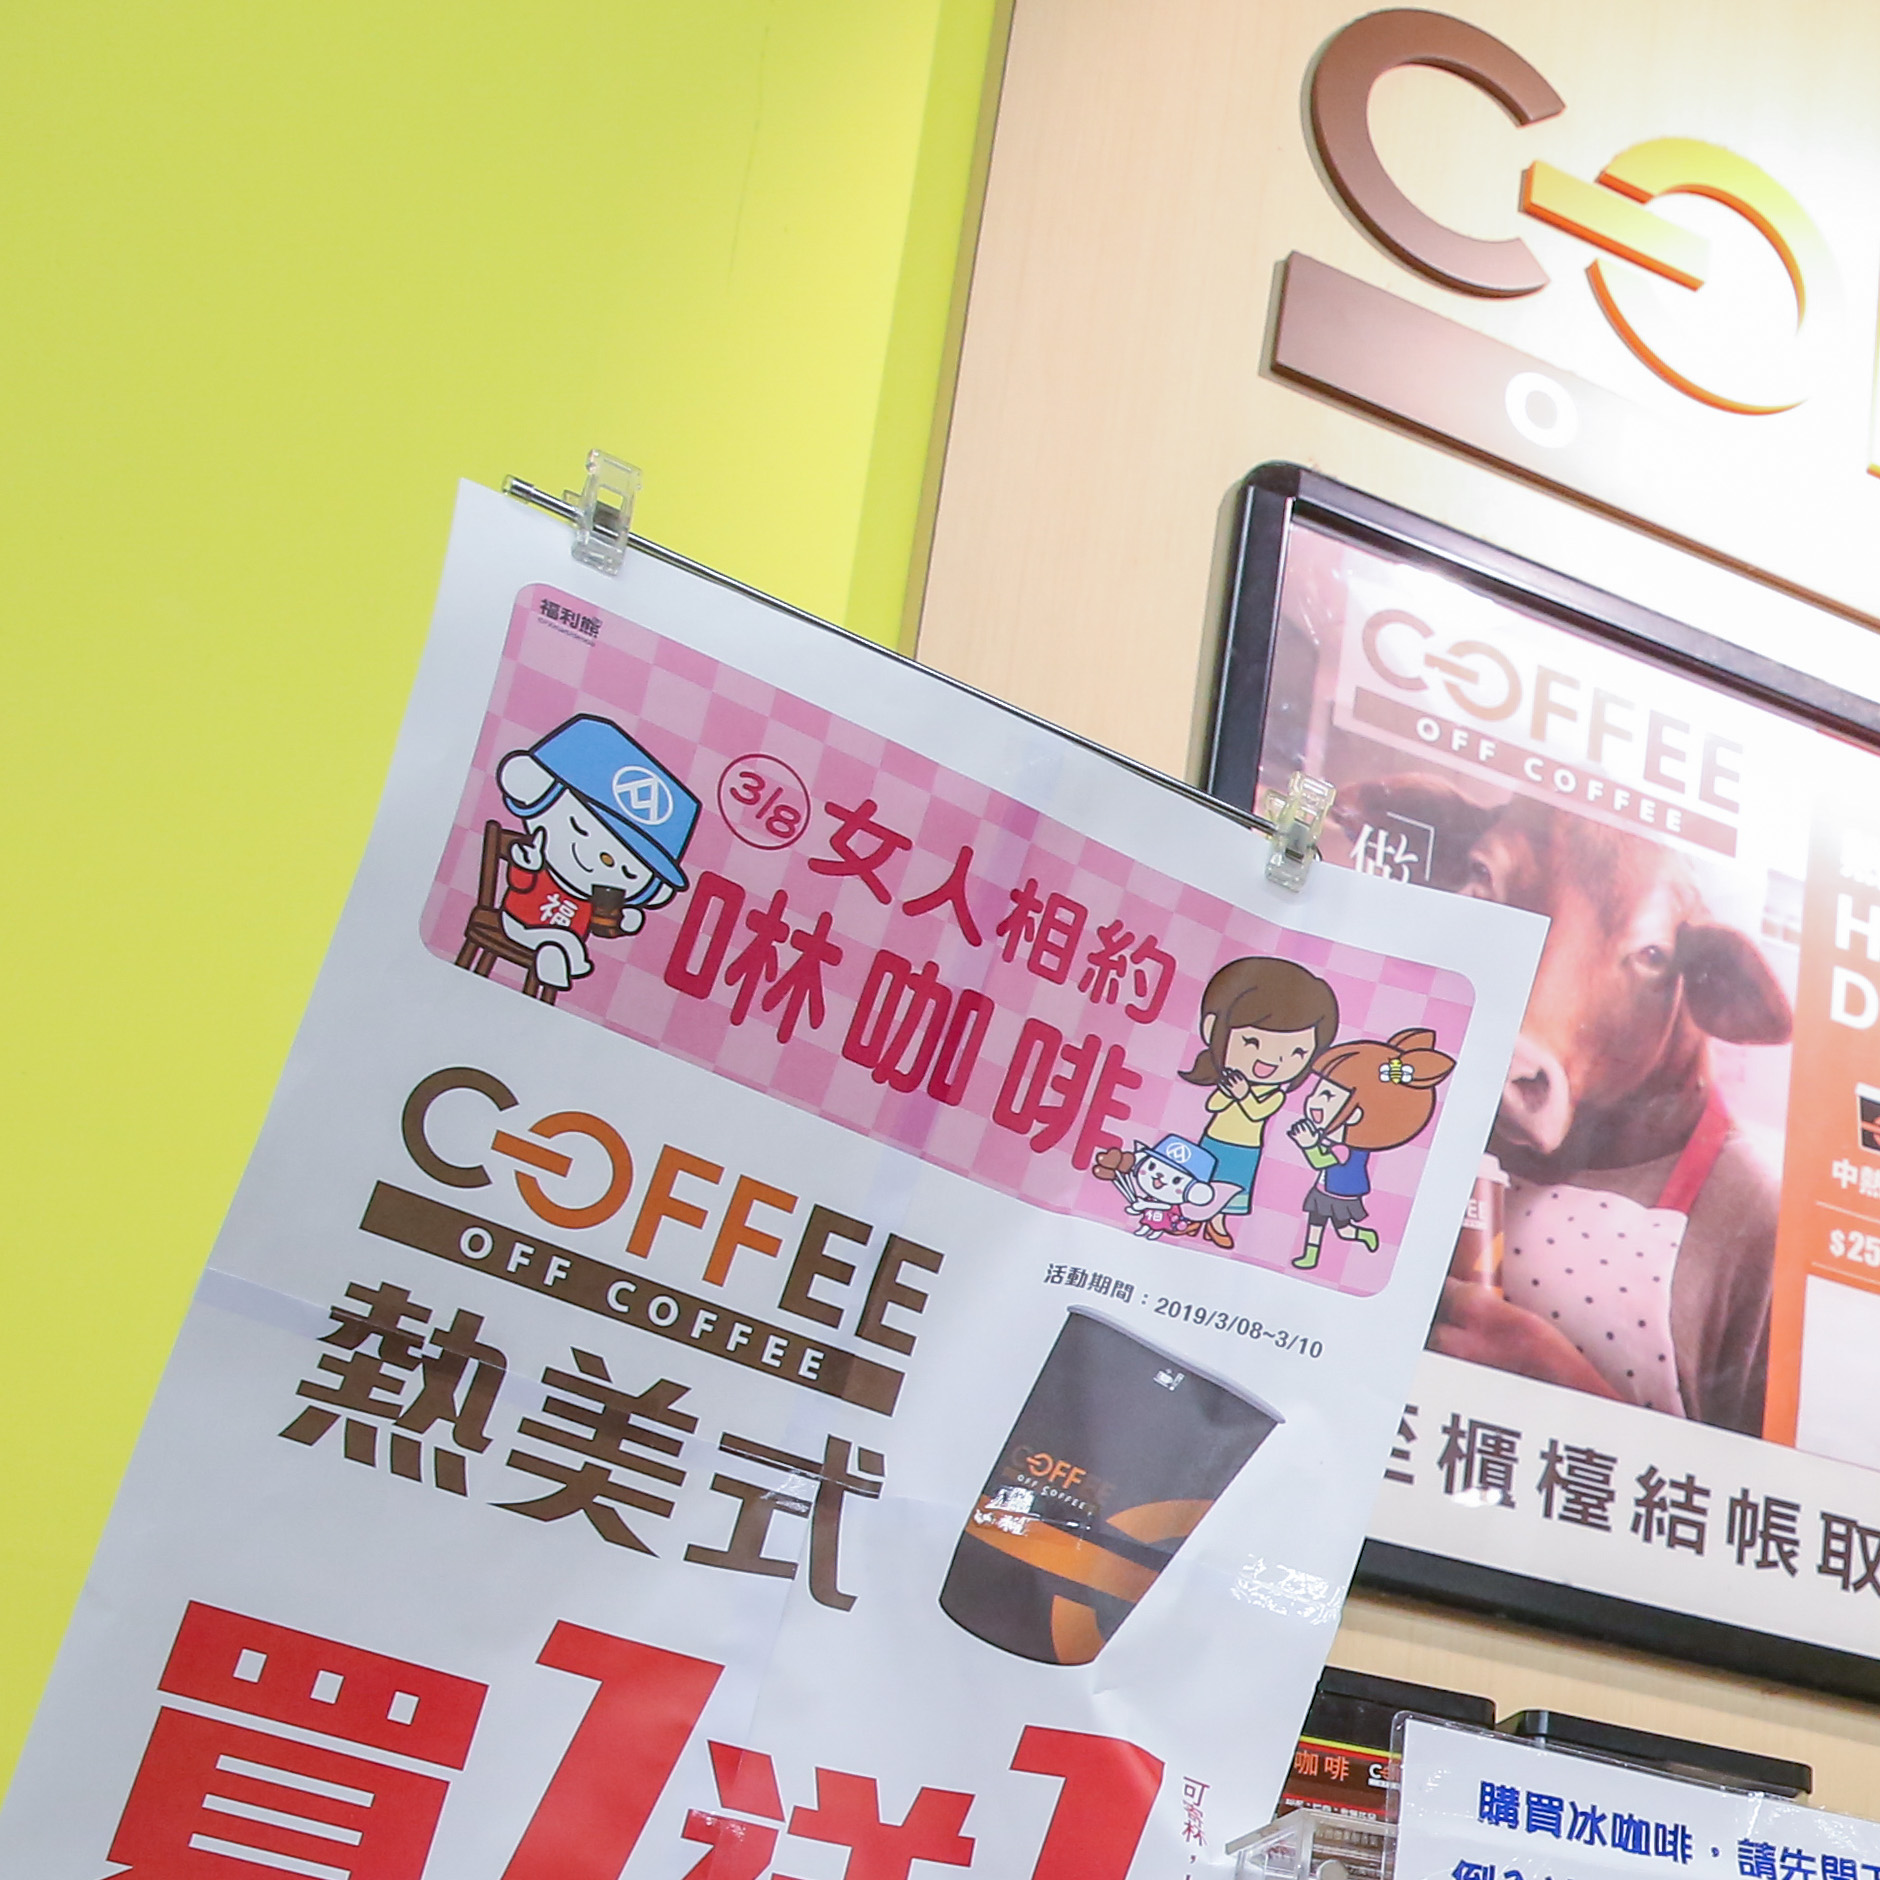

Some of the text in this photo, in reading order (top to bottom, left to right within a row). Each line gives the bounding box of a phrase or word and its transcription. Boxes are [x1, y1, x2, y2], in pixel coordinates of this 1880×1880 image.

[1361, 608, 1744, 816] COFFEE
[1415, 717, 1683, 833] OFF COFFEE
[540, 893, 578, 927] 福
[806, 797, 1179, 1024] 女人相約
[402, 1065, 945, 1358] COFFEE
[458, 1226, 827, 1381] OFF COFFEE
[278, 1278, 885, 1614] 熱美式
